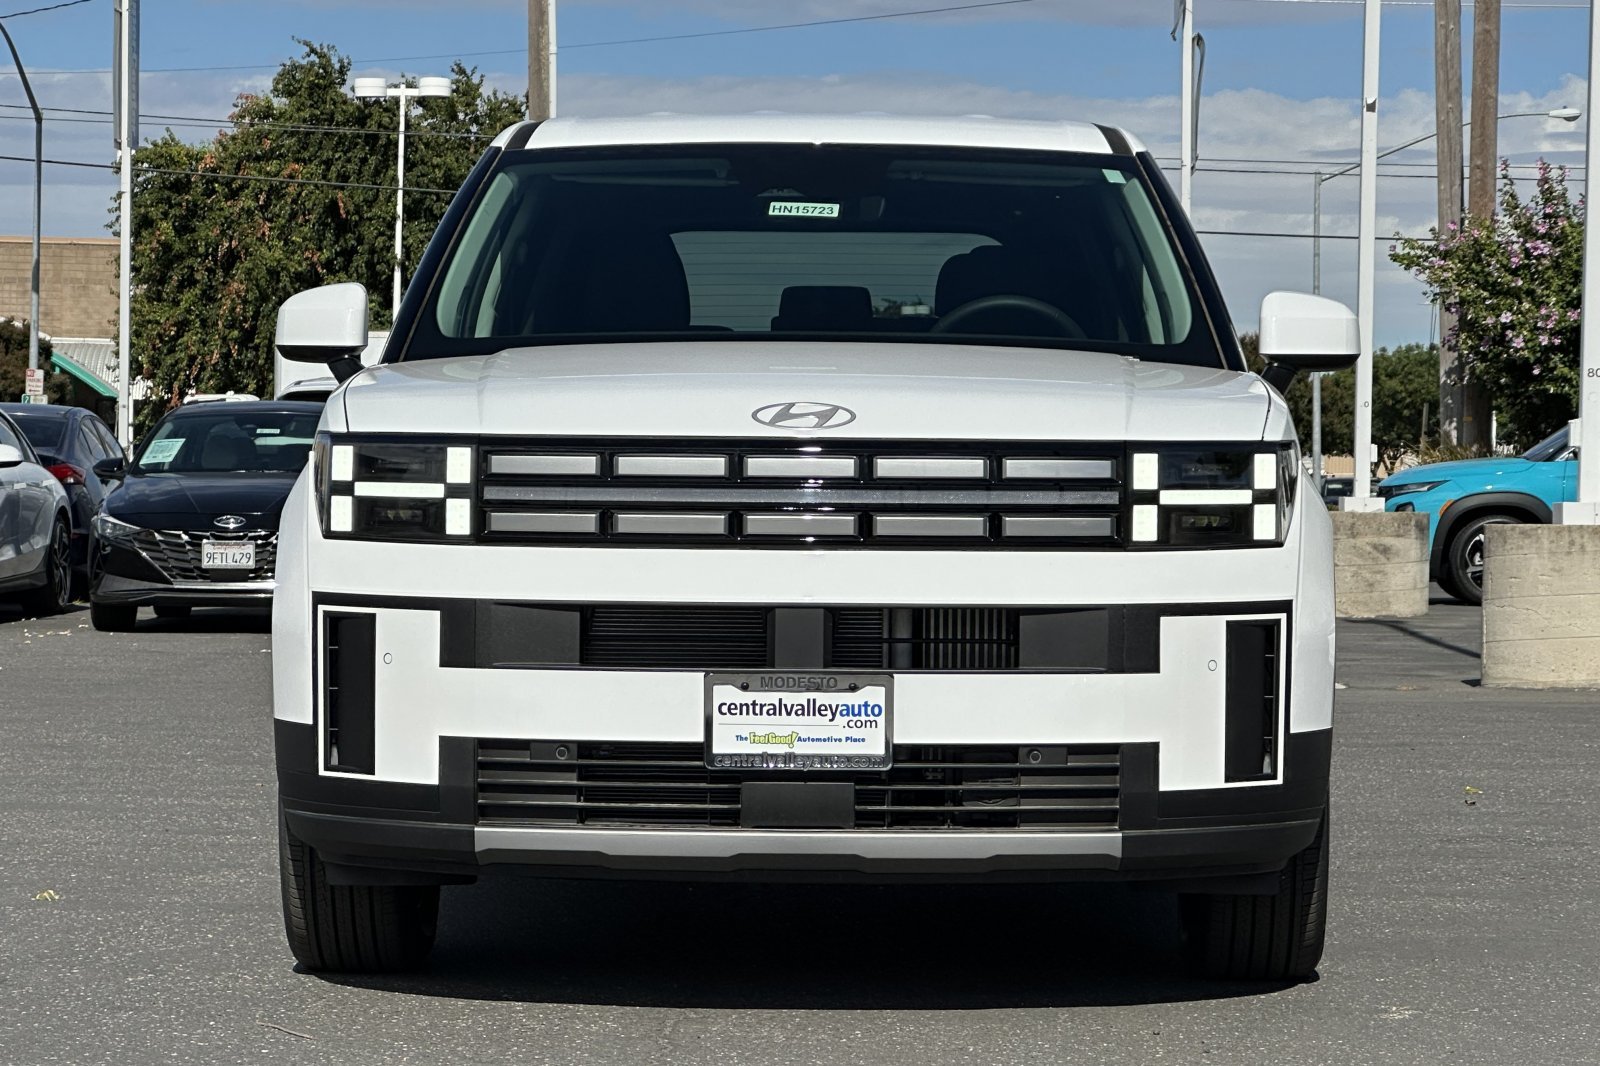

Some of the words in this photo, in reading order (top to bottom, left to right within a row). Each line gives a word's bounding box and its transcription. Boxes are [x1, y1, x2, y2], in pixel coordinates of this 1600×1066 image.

[771, 204, 834, 215] HN15723
[760, 676, 838, 689] MODESTO
[717, 698, 883, 722] centralvalleyauto
[842, 719, 878, 729] .com
[735, 734, 748, 742] The
[796, 735, 843, 743] Automotive
[845, 735, 866, 743] Place
[713, 752, 885, 771] centralvalleyauto.com
